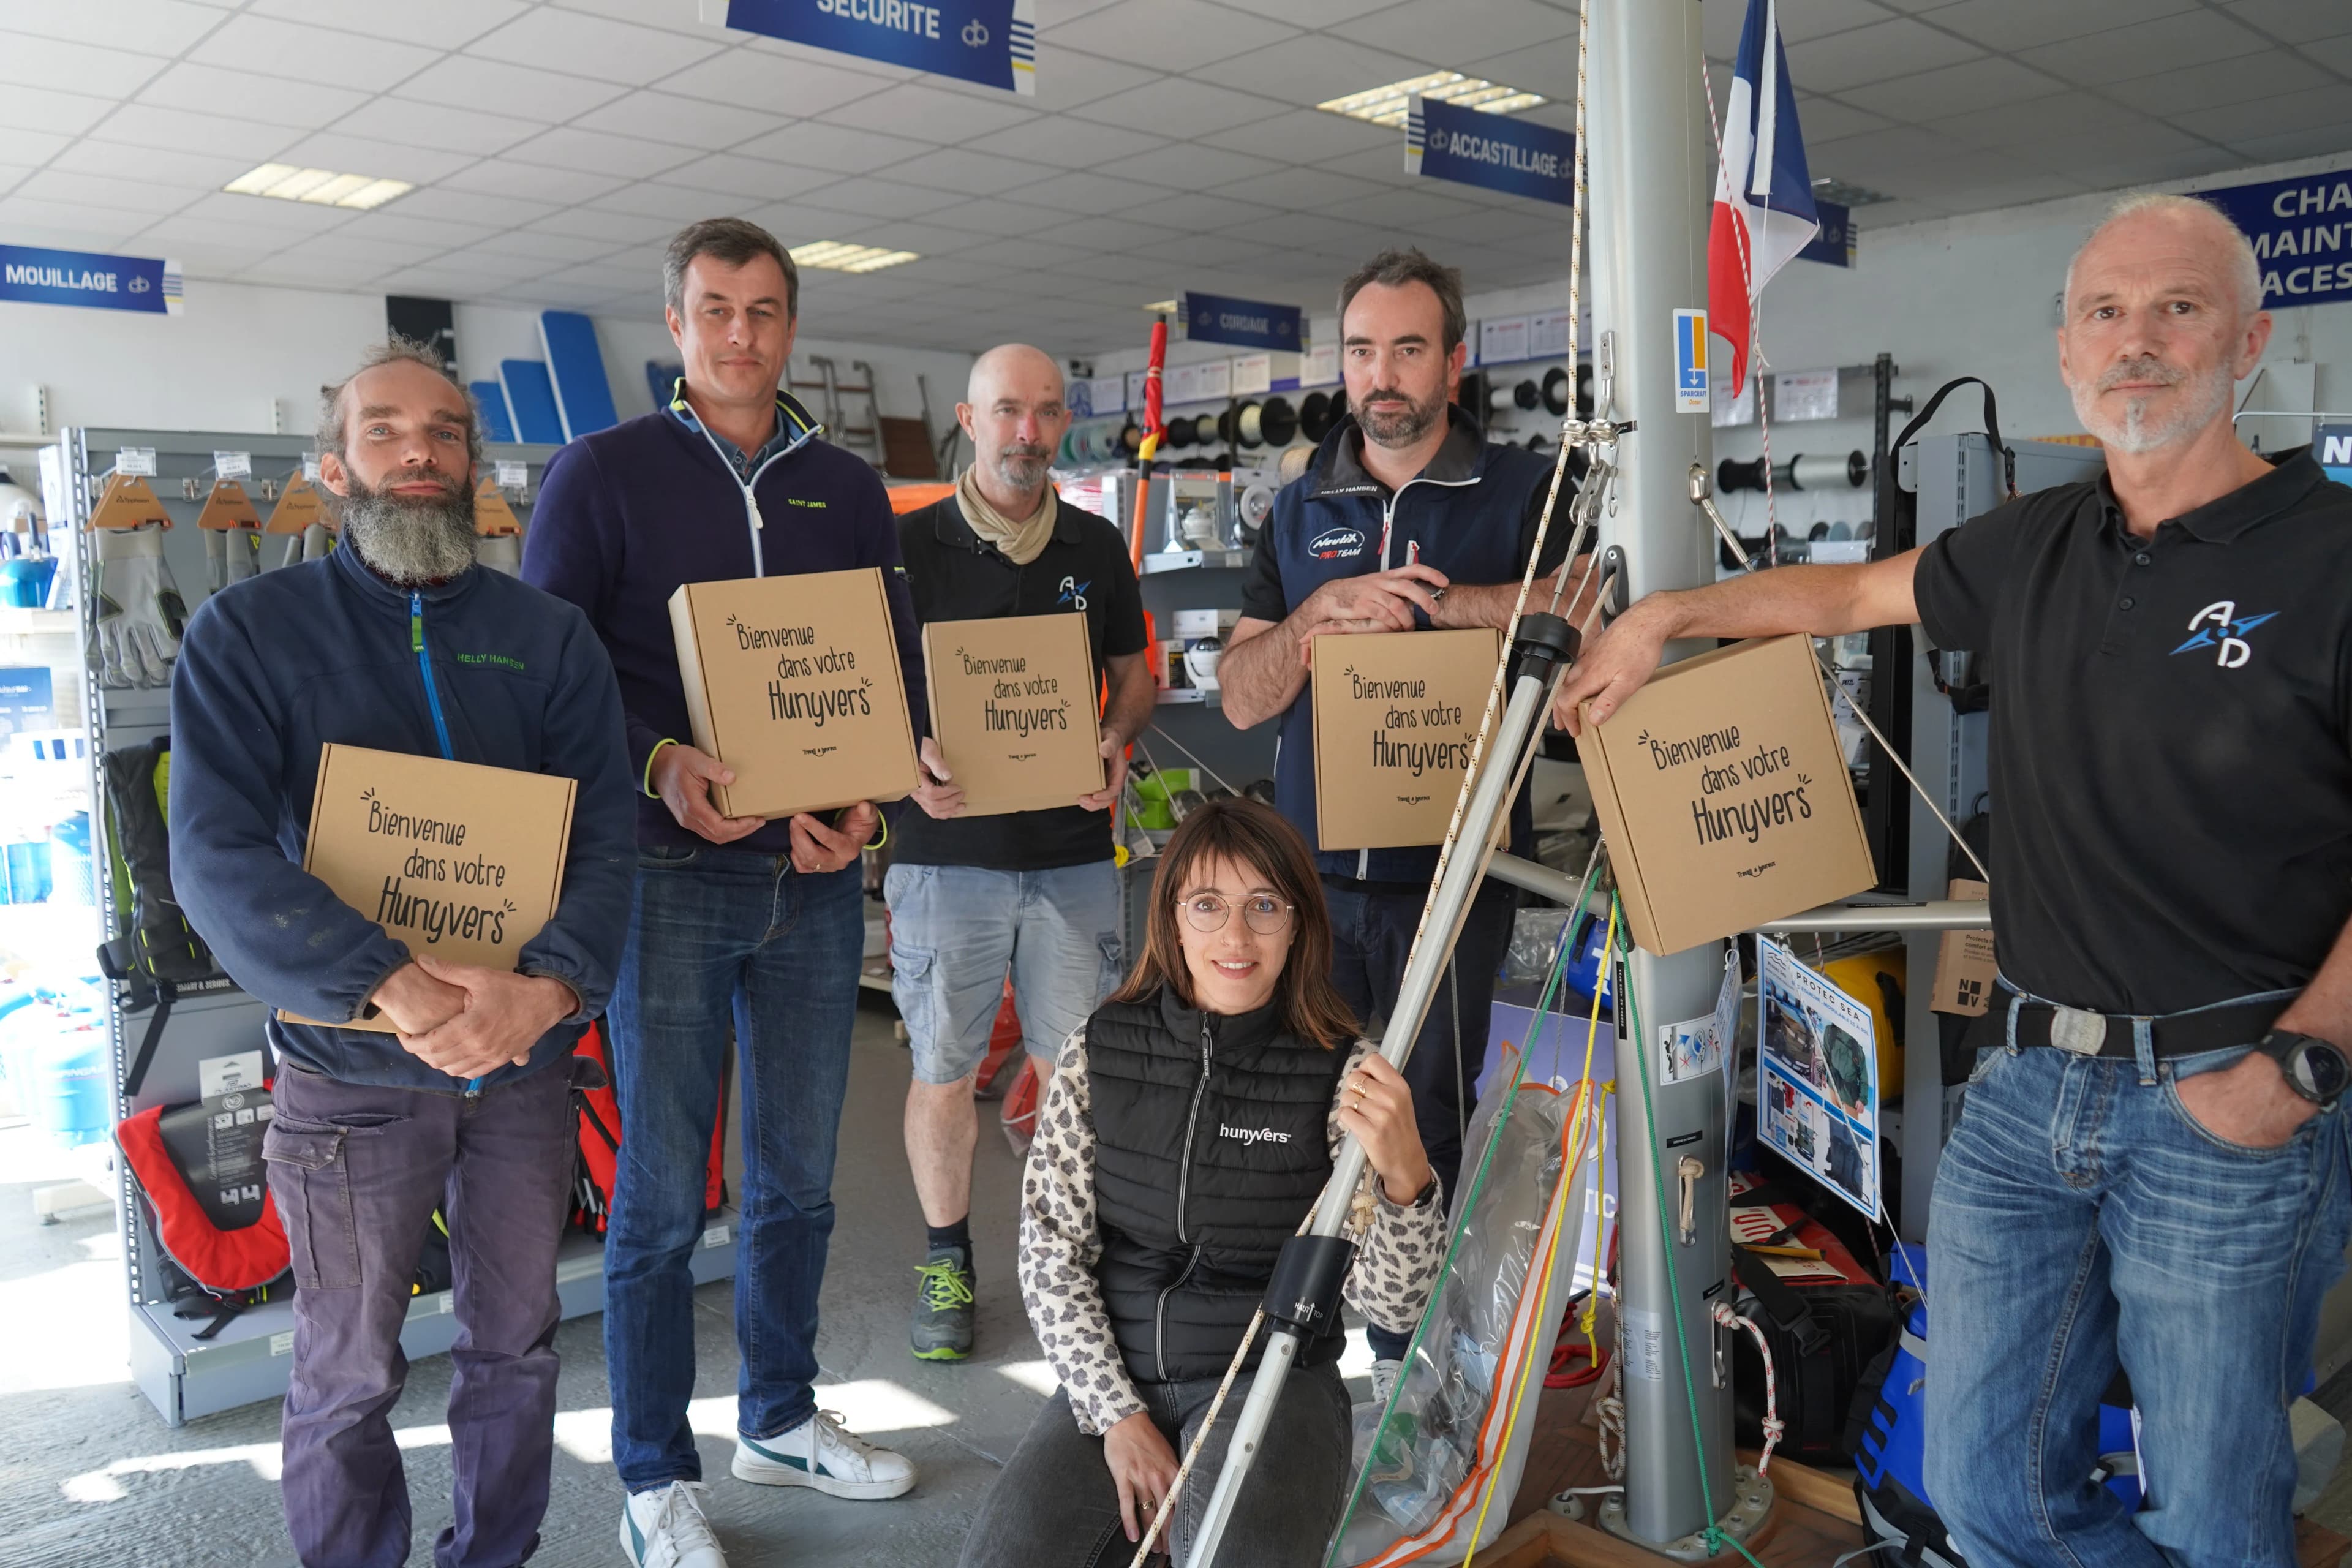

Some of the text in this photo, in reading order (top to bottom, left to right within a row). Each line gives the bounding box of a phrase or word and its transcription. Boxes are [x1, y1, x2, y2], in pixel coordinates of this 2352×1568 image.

[1449, 132, 1558, 178] ACCASTILLAGE
[2273, 183, 2352, 217] CHA
[6, 263, 118, 293] MOUILLAGE
[1219, 313, 1270, 334] CORDAGE
[788, 498, 806, 507] SAINT
[737, 624, 815, 650] Bienvenue
[457, 652, 524, 670] HELLY HANSEN
[778, 646, 855, 679] dans votre
[963, 654, 1025, 675] Bienvenue
[994, 674, 1057, 698] dans votre
[1352, 674, 1425, 699] Bienvenue
[768, 680, 870, 727] Hunyvers
[985, 699, 1067, 737] Hunyvers
[1385, 700, 1461, 729] dans votre
[1373, 729, 1469, 777] Hunyvers
[1650, 726, 1741, 771] Bienvenue
[1701, 744, 1790, 795] dans votre
[368, 800, 466, 846] Bienvenue
[1692, 786, 1812, 845] Hunyvers
[404, 848, 505, 888] dans votre
[376, 876, 505, 944] Hunyvers
[1966, 934, 1988, 944] Protects
[1796, 972, 1835, 1004] PROTEC
[1840, 1002, 1860, 1022] SEA
[1220, 1123, 1288, 1145] hunyvers
[1294, 1302, 1310, 1313] HAUT
[1313, 1310, 1324, 1318] TOP
